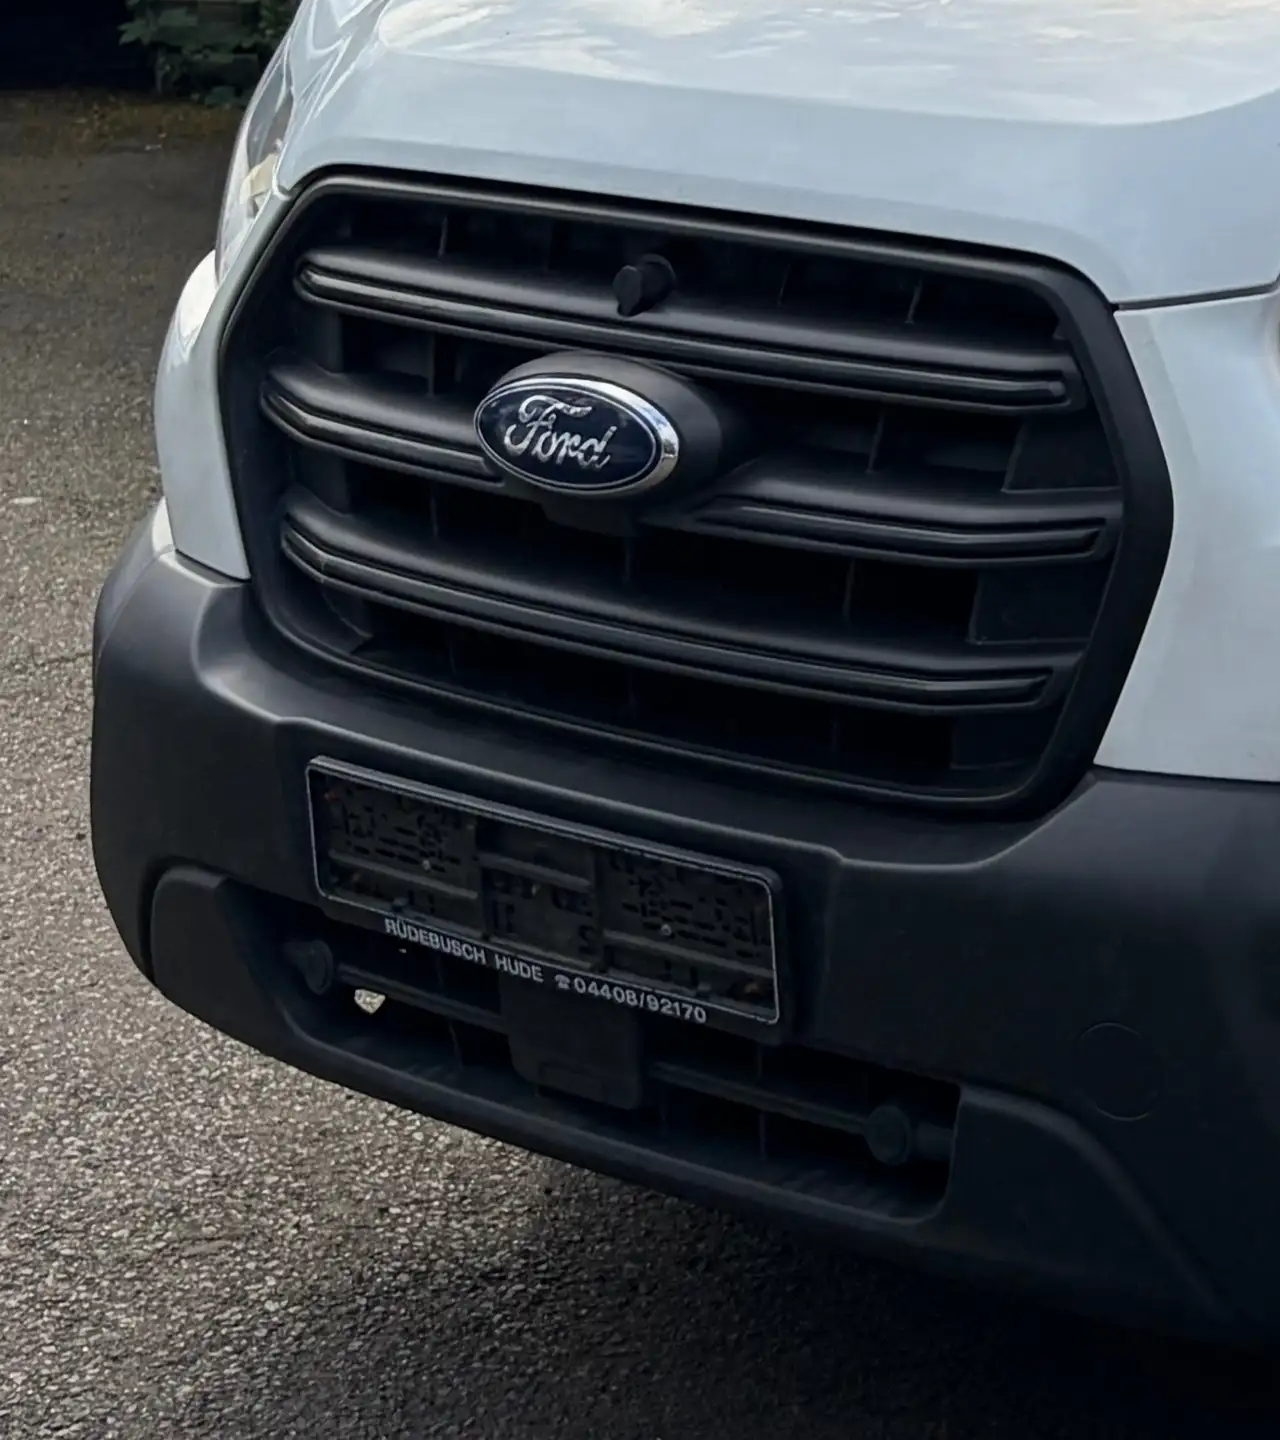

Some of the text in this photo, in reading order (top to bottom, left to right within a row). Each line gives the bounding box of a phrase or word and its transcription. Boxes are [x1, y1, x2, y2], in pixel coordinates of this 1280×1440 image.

[503, 394, 617, 469] Ford
[494, 953, 544, 983] HUDE
[573, 976, 707, 1024] 04408/92170
